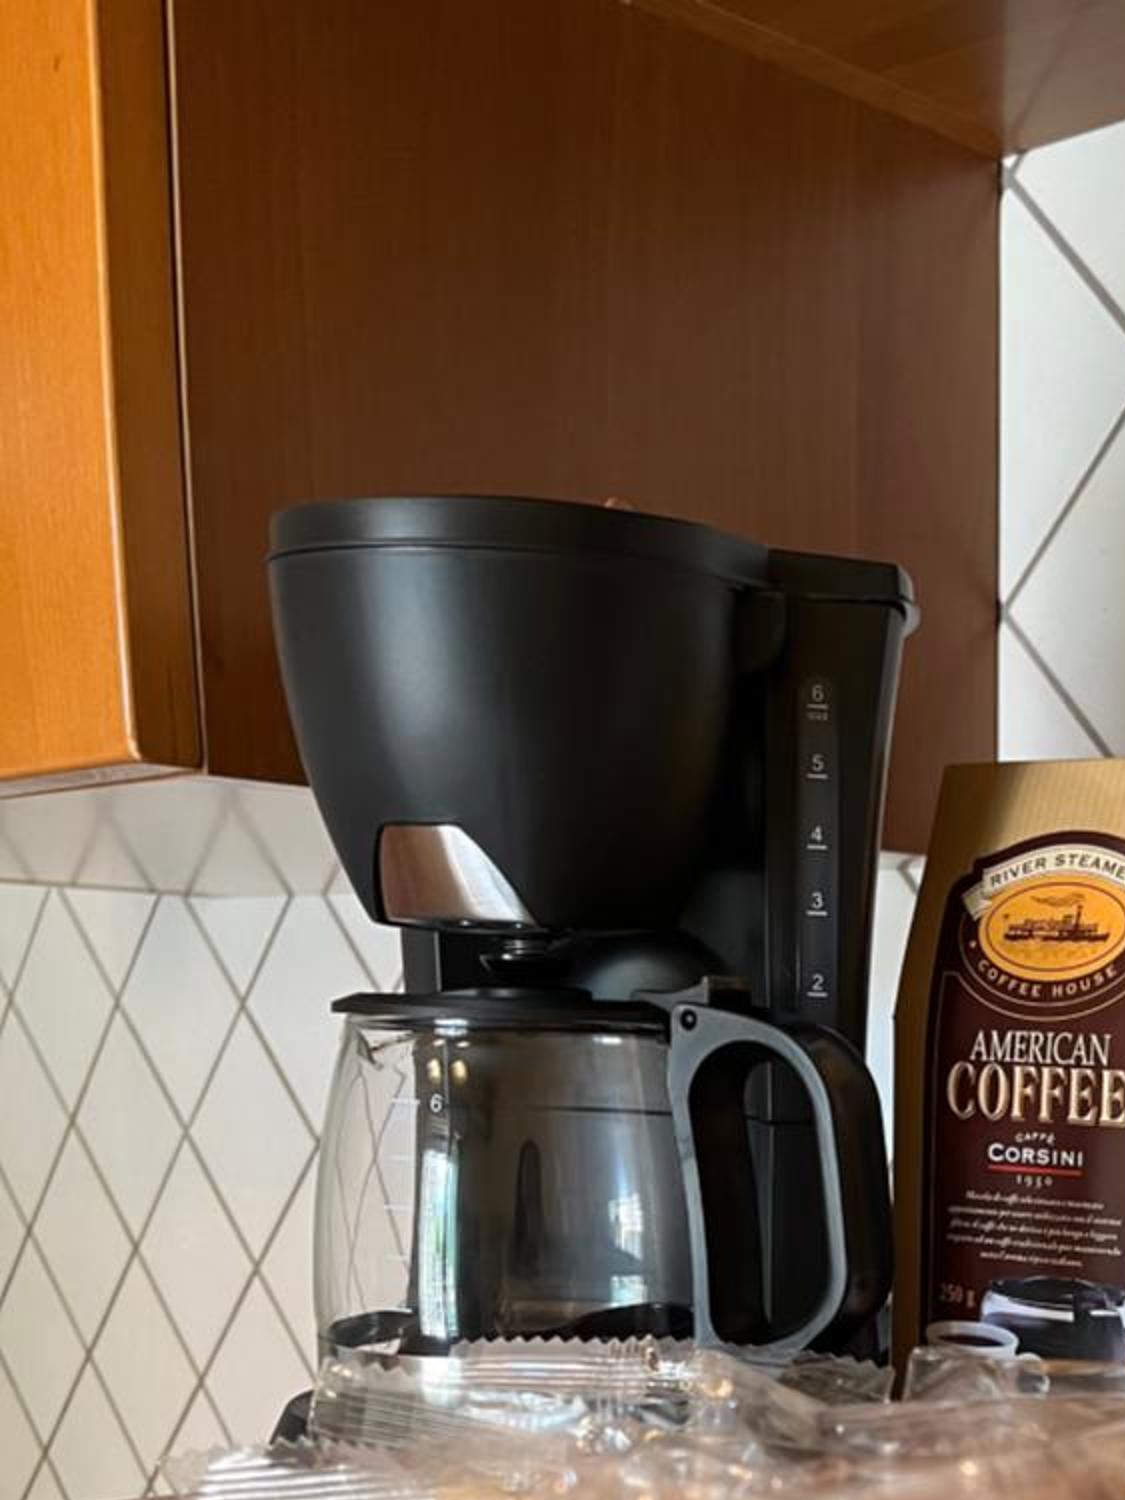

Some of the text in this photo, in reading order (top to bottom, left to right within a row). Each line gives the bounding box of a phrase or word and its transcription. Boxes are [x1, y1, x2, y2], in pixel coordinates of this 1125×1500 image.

[811, 684, 825, 702] 6
[811, 754, 824, 771] 5
[811, 825, 823, 841] 4
[989, 856, 1047, 888] RIVER
[811, 891, 823, 909] 3
[811, 973, 824, 991] 2
[977, 959, 1118, 997] COFFEE HOUSE
[969, 1029, 1112, 1067] AMERICAN
[429, 1093, 443, 1113] 6
[987, 1143, 1084, 1168] CORSINI
[1016, 1174, 1054, 1189] 1950
